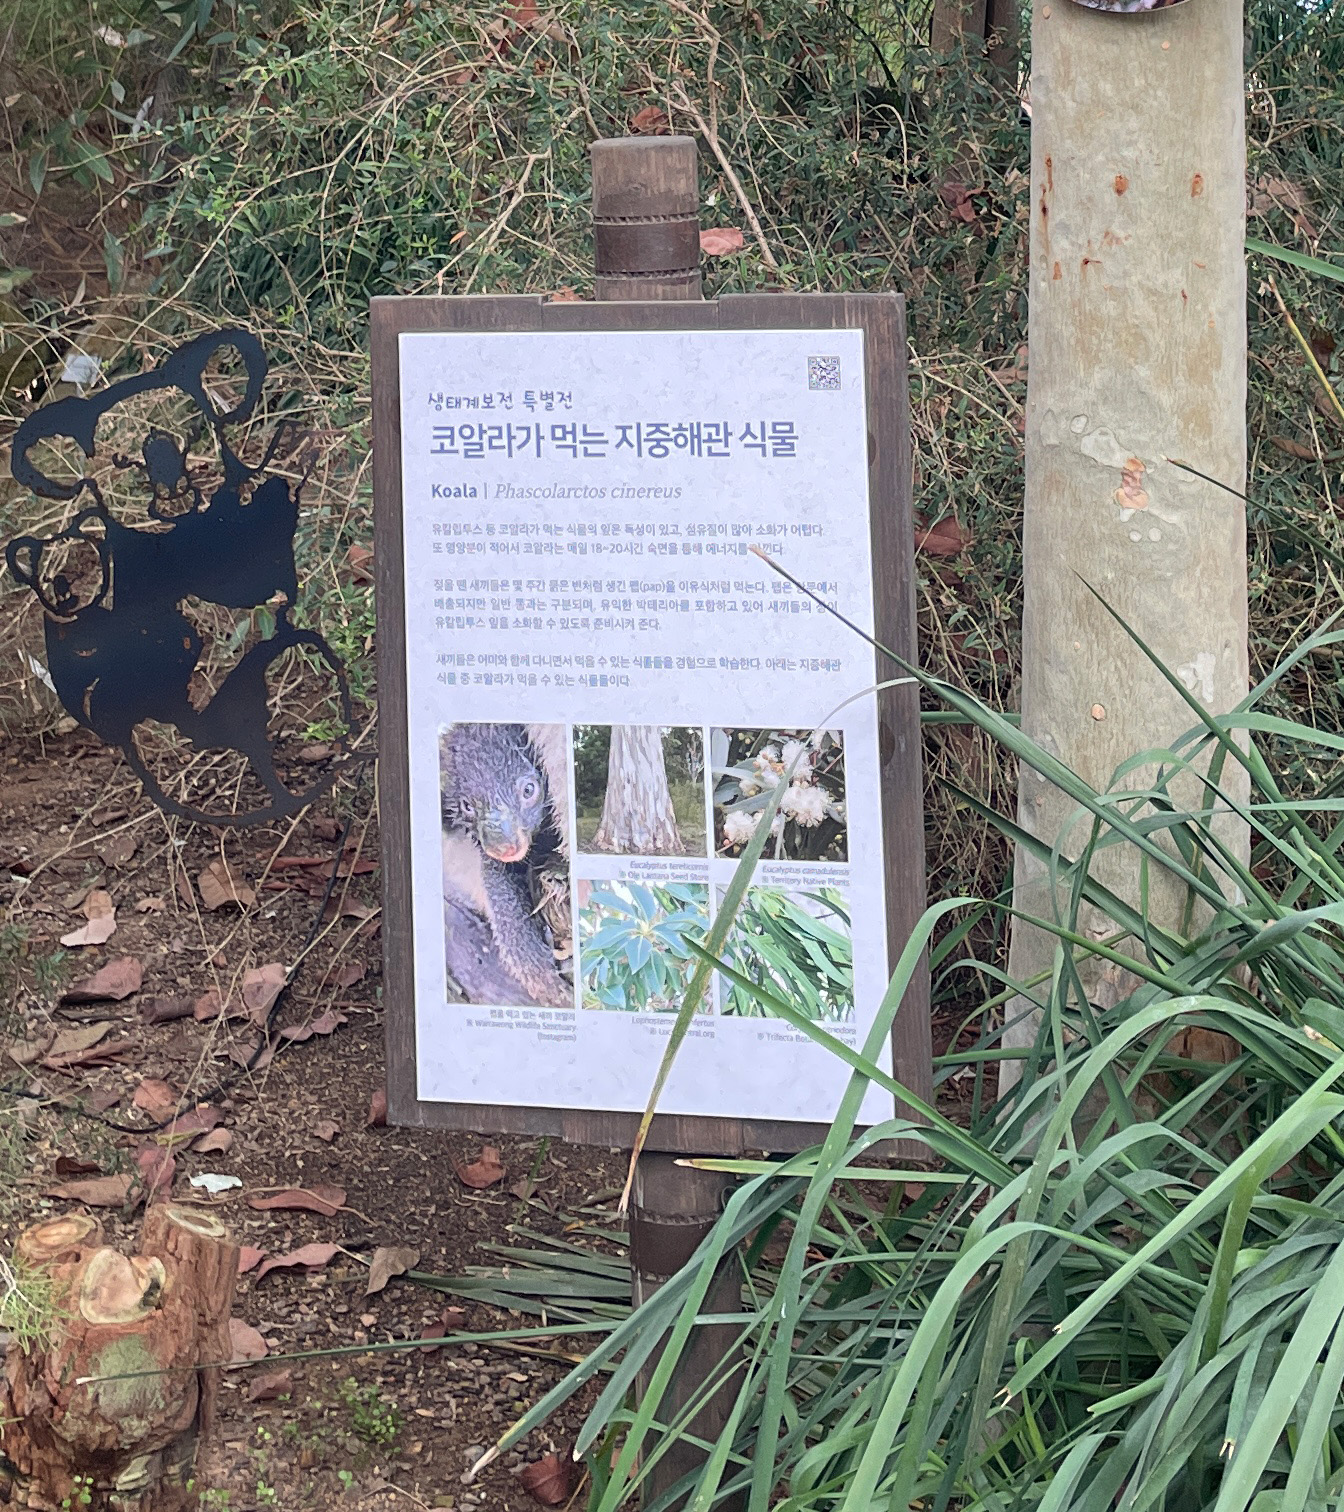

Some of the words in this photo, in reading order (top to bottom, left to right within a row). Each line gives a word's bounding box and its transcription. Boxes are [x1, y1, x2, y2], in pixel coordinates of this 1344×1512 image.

[428, 392, 514, 411] 생태계보전
[523, 390, 573, 412] 특별전
[430, 422, 545, 458] 코알라가
[551, 423, 608, 458] 먹는
[615, 421, 733, 458] 지중해관
[739, 421, 799, 458] 식물
[432, 483, 477, 498] Koala
[494, 482, 606, 499] Phascolarctos
[611, 483, 682, 499] cinereus
[498, 523, 540, 536] 코알라가
[543, 524, 564, 536] 먹는
[567, 523, 597, 536] 식물의
[625, 523, 655, 536] 독성이
[686, 524, 728, 536] 섬유질이
[731, 524, 752, 536] 많아
[756, 524, 788, 536] 소화가
[433, 542, 443, 554] 또
[446, 542, 486, 555] 영양분이
[490, 542, 520, 555] 적어서
[523, 543, 564, 555] 코알라는
[567, 543, 588, 555] 매일
[648, 543, 678, 555] 숙면을
[682, 543, 702, 555] 통해
[469, 579, 510, 592] 새끼들은
[526, 579, 545, 592] 주간
[606, 580, 626, 592] 생긴
[679, 581, 731, 594] 이유식처럼
[434, 598, 486, 611] 배출되지만
[491, 598, 511, 611] 일반
[601, 599, 632, 612] 유익한
[695, 600, 738, 612] 포함하고
[742, 600, 763, 613] 있어
[546, 617, 556, 629] 수
[436, 654, 476, 666] 새끼들은
[478, 654, 507, 667] 어미와
[510, 654, 530, 667] 함께
[533, 655, 572, 667] 다니면서
[598, 656, 608, 667] 수
[610, 656, 631, 668] 있는
[765, 657, 797, 671] 아래는
[460, 672, 470, 685] 중
[474, 673, 515, 686] 코알라가
[541, 674, 551, 686] 수
[554, 674, 575, 686] 있는
